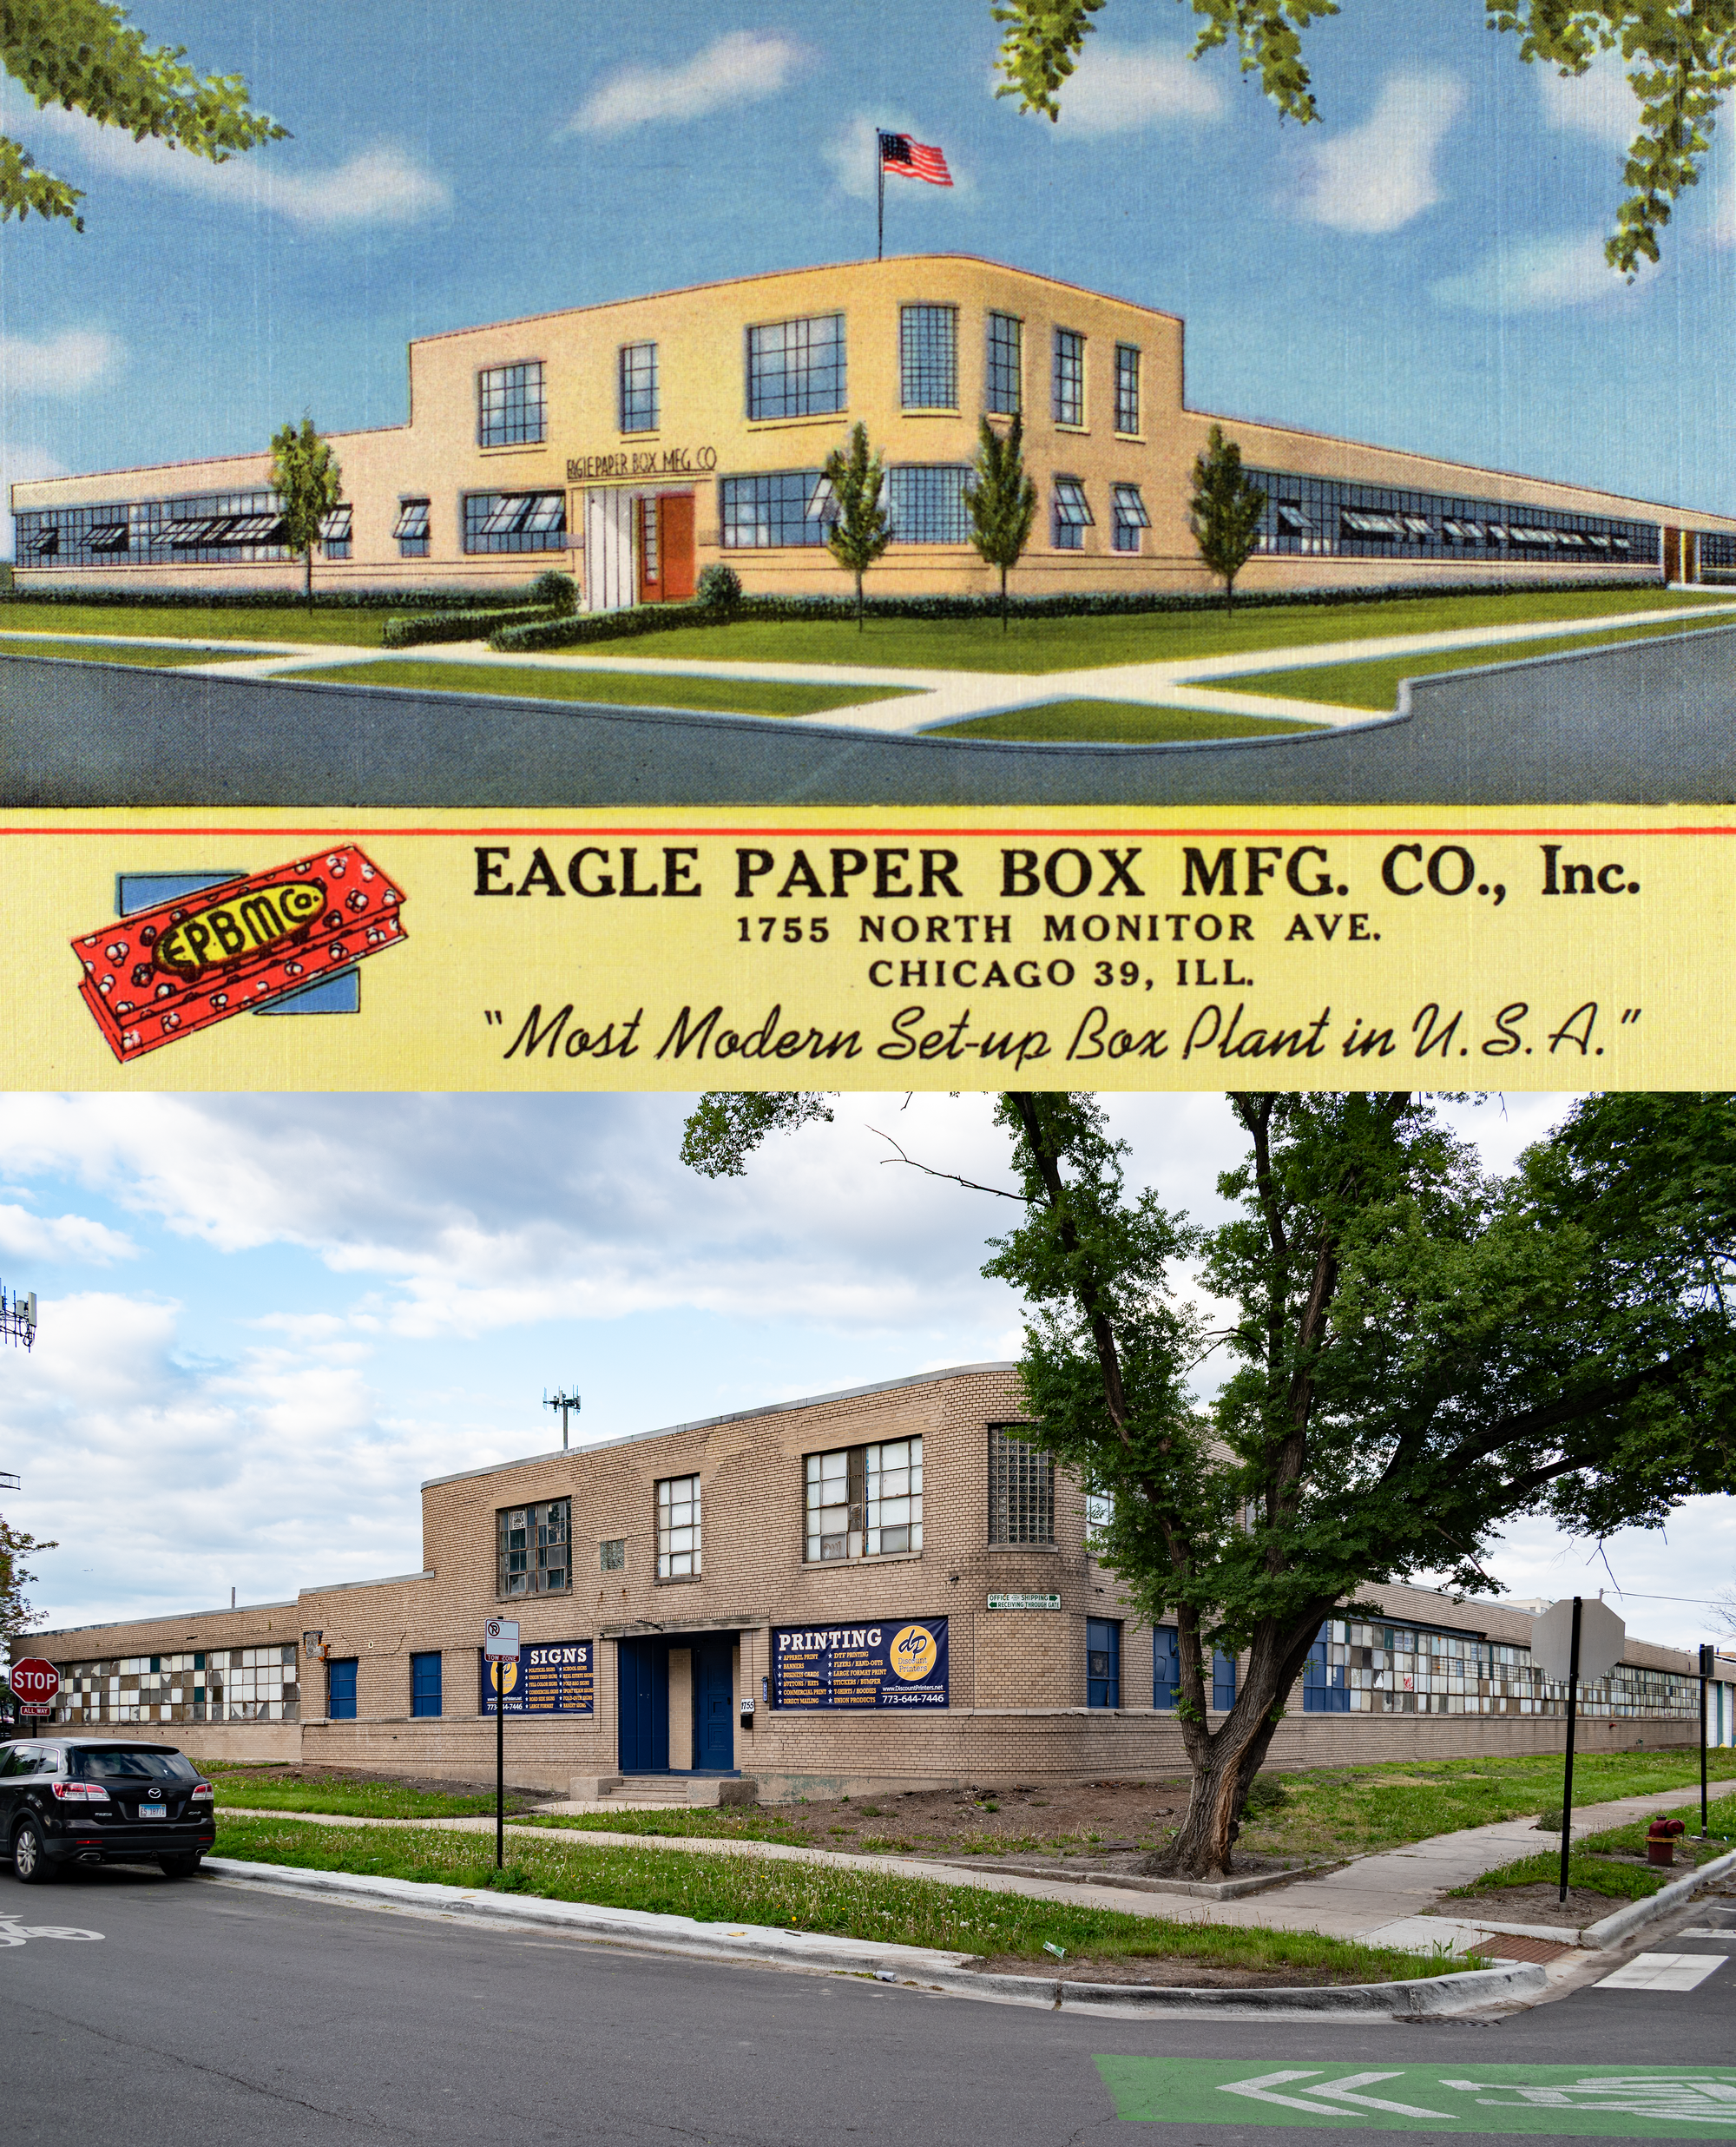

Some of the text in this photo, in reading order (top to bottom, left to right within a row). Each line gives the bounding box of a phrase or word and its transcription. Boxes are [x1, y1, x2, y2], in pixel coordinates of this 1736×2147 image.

[595, 452, 628, 477] PAPER
[632, 451, 656, 473] BOX
[663, 447, 691, 471] MFG
[697, 445, 717, 470] CO
[474, 843, 1640, 906] EAGLE PAPER BOX MFG. CO., Inc.
[737, 913, 1381, 943] 1755 NORTH MONITOR AVE.
[869, 958, 1253, 991] CHICAGO 39, ILL.
[484, 1004, 643, 1059] "Most
[655, 1004, 863, 1060] Modern
[877, 1005, 1051, 1069] Set-up
[1066, 1006, 1168, 1061] Box
[1182, 1003, 1331, 1060] Plant
[1342, 1018, 1396, 1057] in
[779, 1629, 883, 1651] PRINTING
[530, 1648, 587, 1665] SIGNS
[14, 1671, 57, 1690] STOP
[740, 1701, 754, 1710] 1755
[882, 1694, 944, 1703] 773-644-7446
